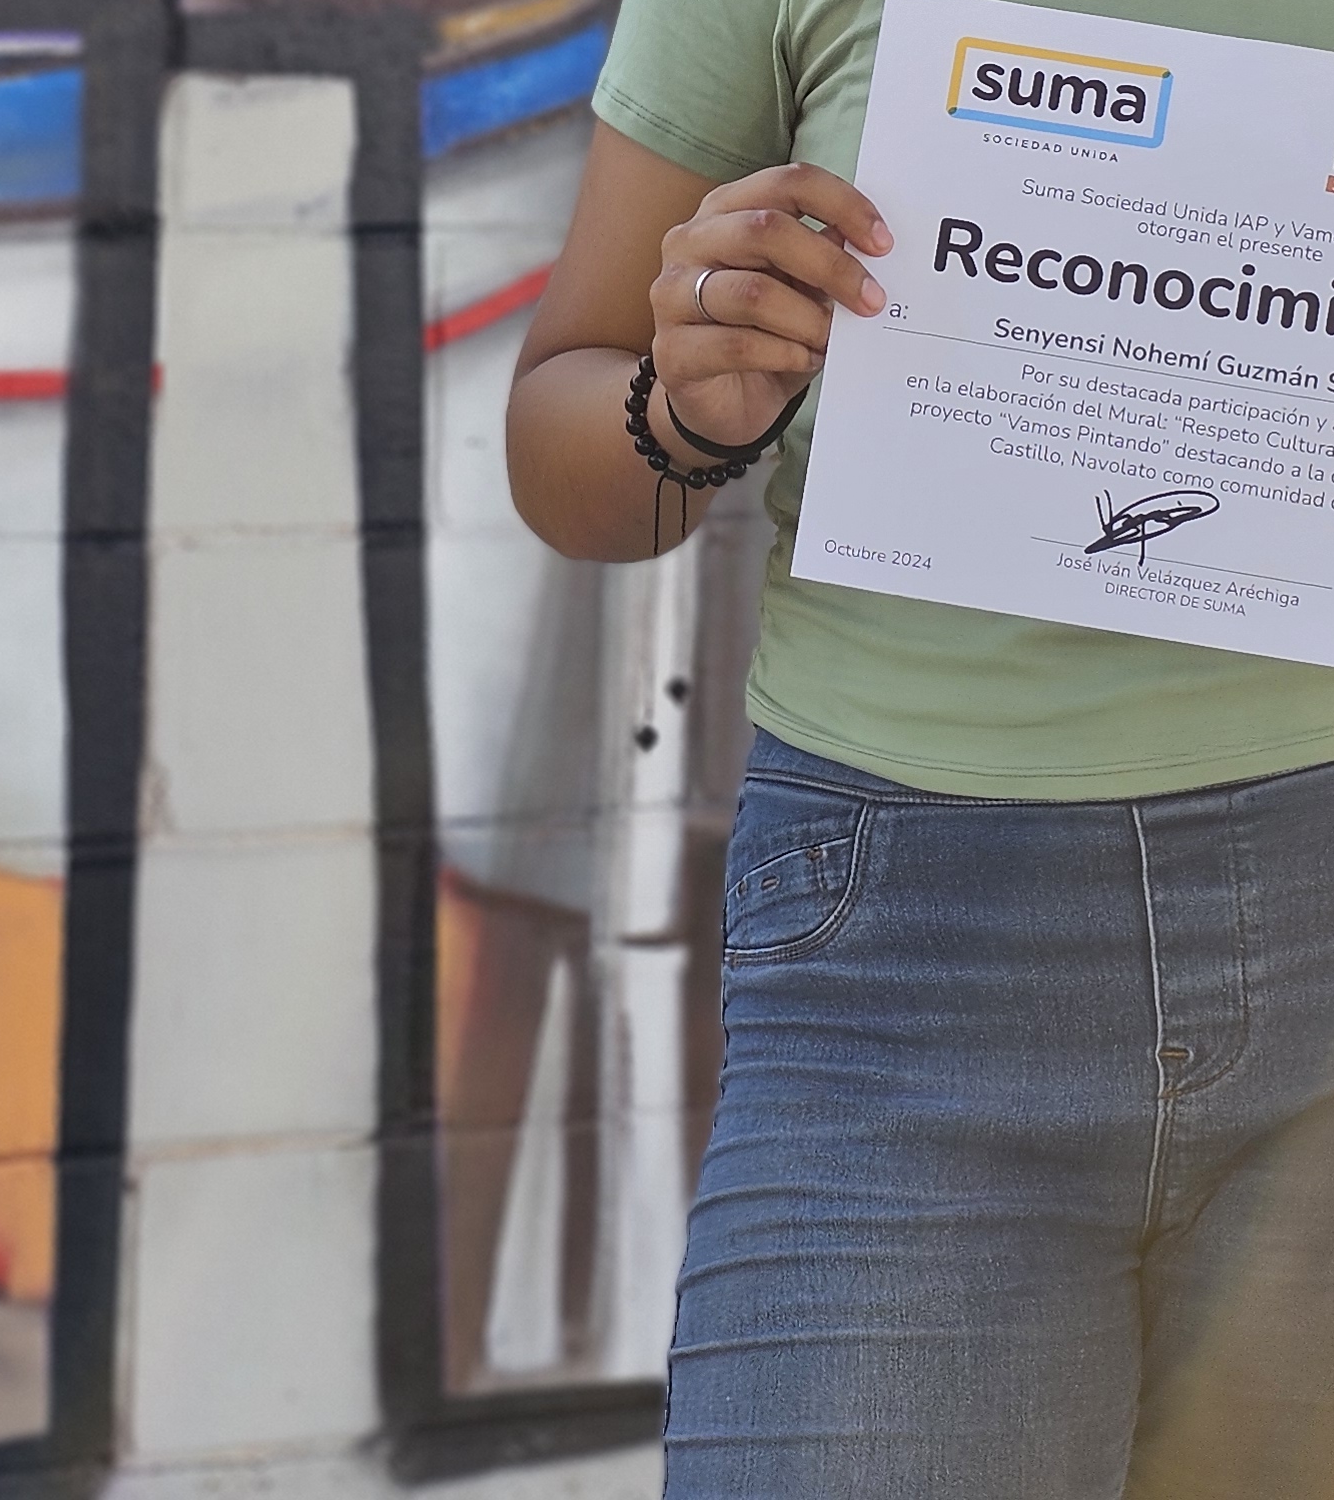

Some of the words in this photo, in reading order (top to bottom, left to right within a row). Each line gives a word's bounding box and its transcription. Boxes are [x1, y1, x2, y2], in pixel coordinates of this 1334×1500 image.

[971, 63, 1147, 124] suma
[983, 133, 1063, 153] SOCIEDAD
[1070, 146, 1119, 163] UNIDA
[1021, 178, 1075, 202] Suma
[1080, 187, 1168, 216] Sociedad
[1173, 202, 1228, 227] Unida
[1234, 211, 1269, 232] IAP
[1274, 222, 1286, 238] y
[1137, 220, 1211, 245] otorgan
[1216, 231, 1234, 249] el
[1239, 238, 1324, 262] presente
[889, 302, 909, 320] a:
[993, 317, 1106, 355] Senyensi
[1112, 336, 1212, 372] Nohemí
[1217, 354, 1319, 390] Guzmán
[906, 375, 929, 391] en
[935, 375, 952, 394] la
[957, 381, 1066, 413] elaboración
[1072, 399, 1103, 420] del
[1108, 404, 1168, 430] Mural:
[1174, 415, 1260, 445] “Respeto
[1021, 363, 1055, 384] Por
[1058, 374, 1080, 389] su
[1086, 376, 1183, 407] destacada
[1187, 396, 1310, 428] participación
[1316, 417, 1328, 433] y
[909, 402, 992, 427] proyecto
[999, 412, 1072, 440] “Vamos
[1077, 424, 1170, 455] Pintando”
[1174, 442, 1285, 476] destacando
[1290, 465, 1302, 478] a
[1308, 463, 1325, 482] la
[989, 437, 1064, 467] Castillo,
[1071, 450, 1157, 480] Navolato
[1162, 470, 1215, 489] como
[1220, 479, 1326, 508] comunidad
[824, 539, 887, 563] Octubre
[891, 550, 932, 570] 2024
[1056, 552, 1092, 572] José
[1096, 559, 1131, 579] Iván
[1136, 566, 1222, 594] Velázquez
[1225, 581, 1300, 608] Aréchiga
[1104, 581, 1177, 605] DIRECTOR
[1179, 594, 1200, 609] DE
[1202, 598, 1246, 617] SUMA
